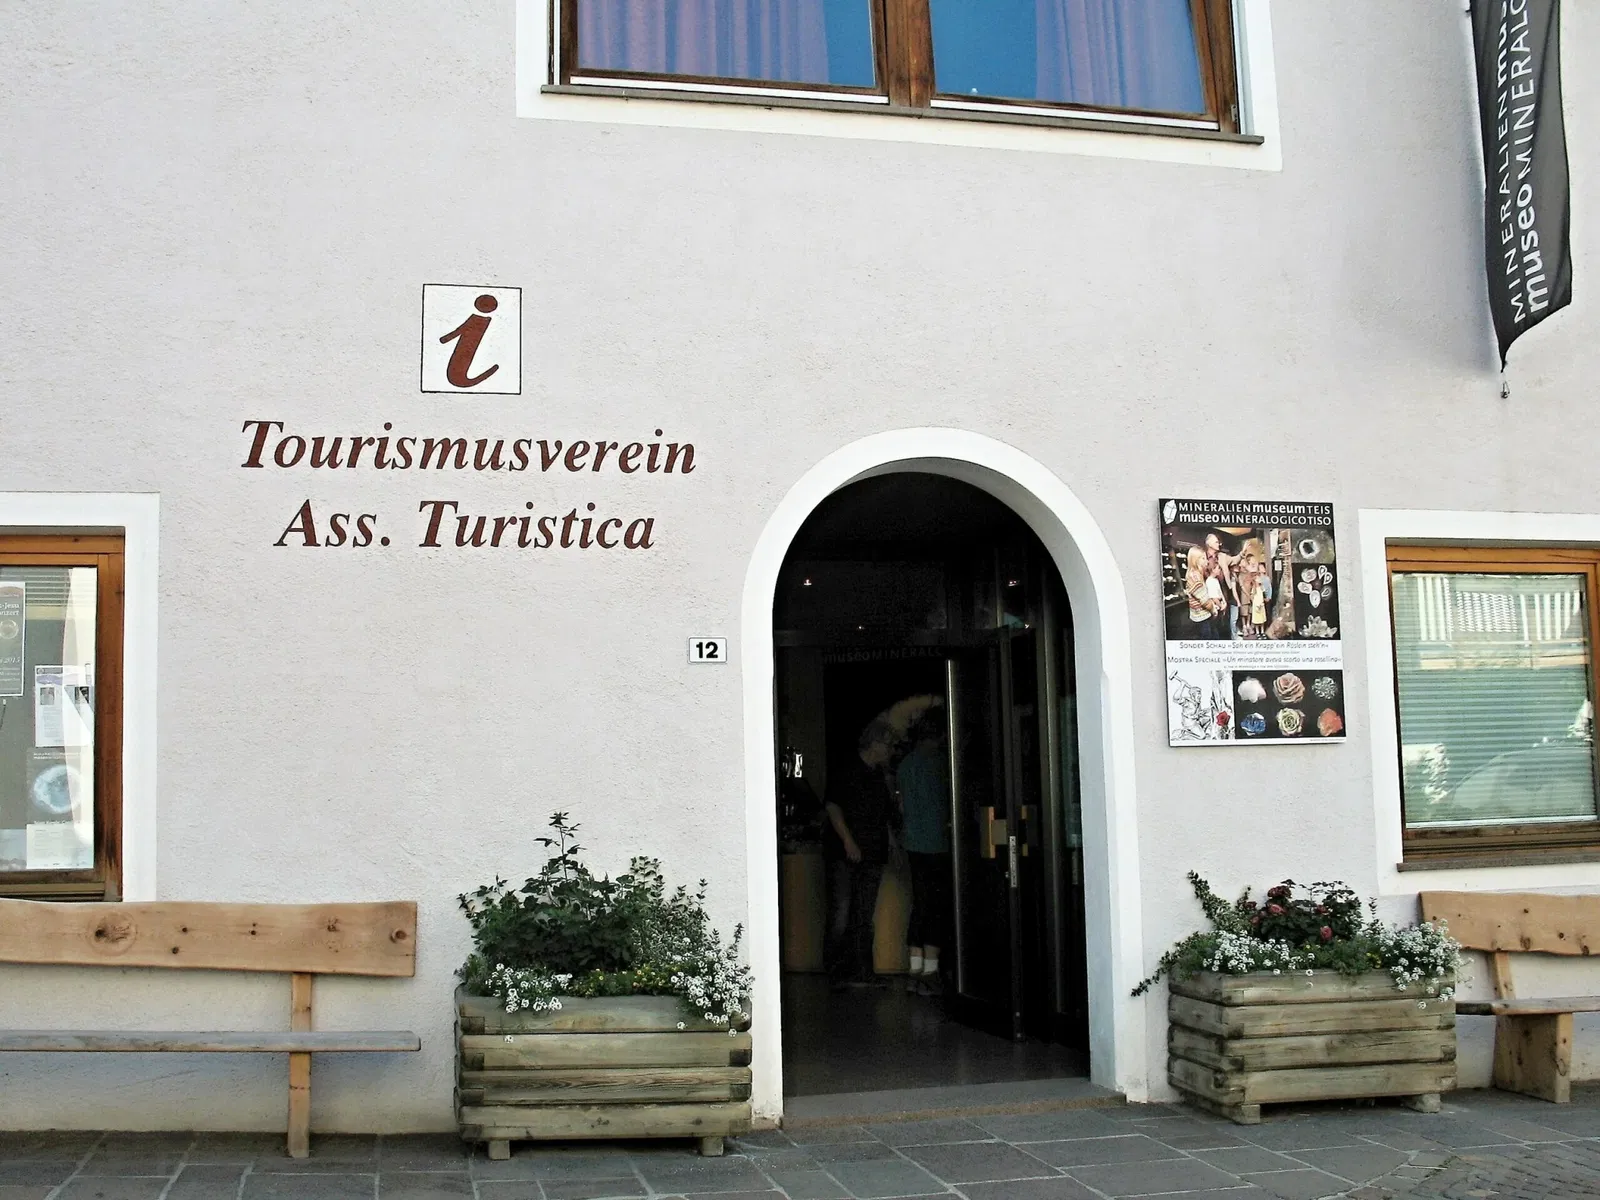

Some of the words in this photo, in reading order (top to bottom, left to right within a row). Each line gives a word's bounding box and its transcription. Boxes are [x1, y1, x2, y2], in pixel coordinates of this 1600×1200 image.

[439, 294, 500, 388] i
[241, 420, 696, 474] Tourismusverein
[273, 498, 391, 547] Ass.
[418, 501, 656, 550] Turistica
[695, 641, 719, 659] 12
